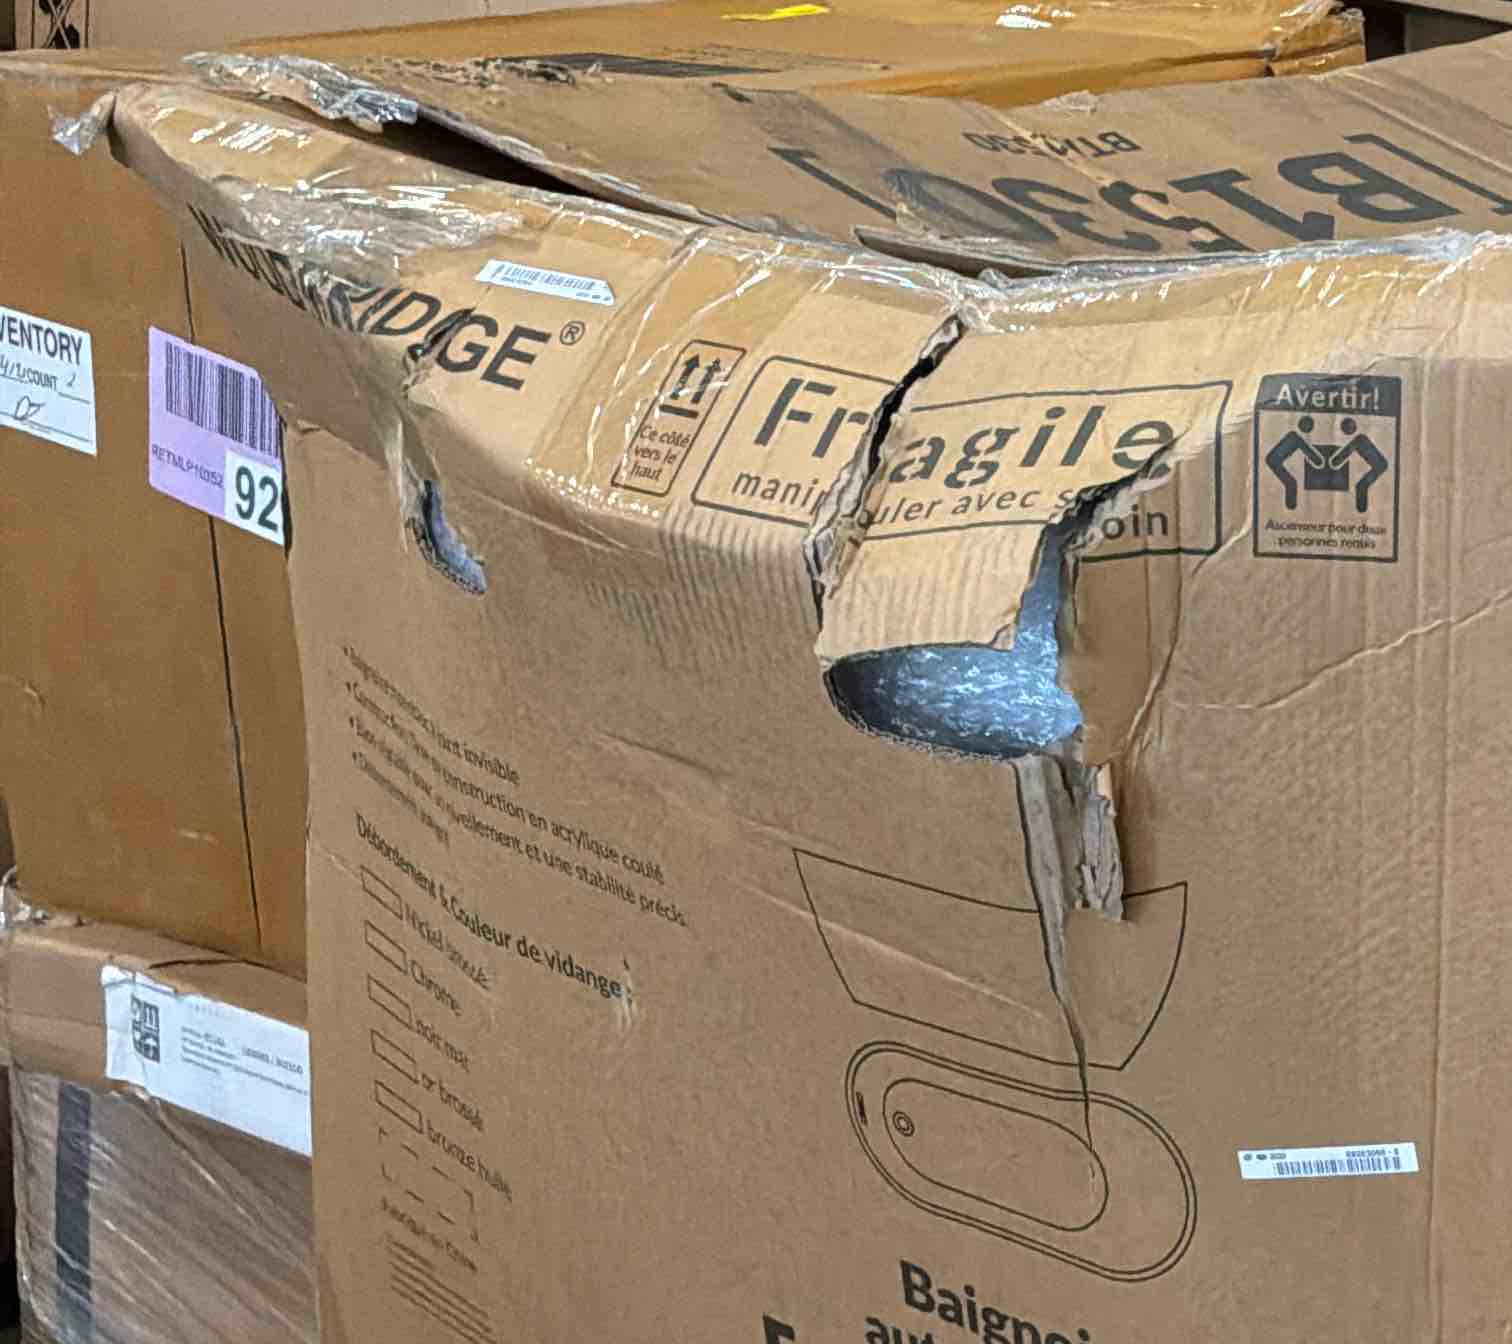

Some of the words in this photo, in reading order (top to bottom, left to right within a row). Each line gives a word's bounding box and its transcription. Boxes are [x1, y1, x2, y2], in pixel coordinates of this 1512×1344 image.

[630, 462, 664, 482] haut
[234, 464, 280, 532] 92
[950, 487, 1036, 517] avec
[551, 820, 619, 866] acrylique
[516, 935, 542, 964] de
